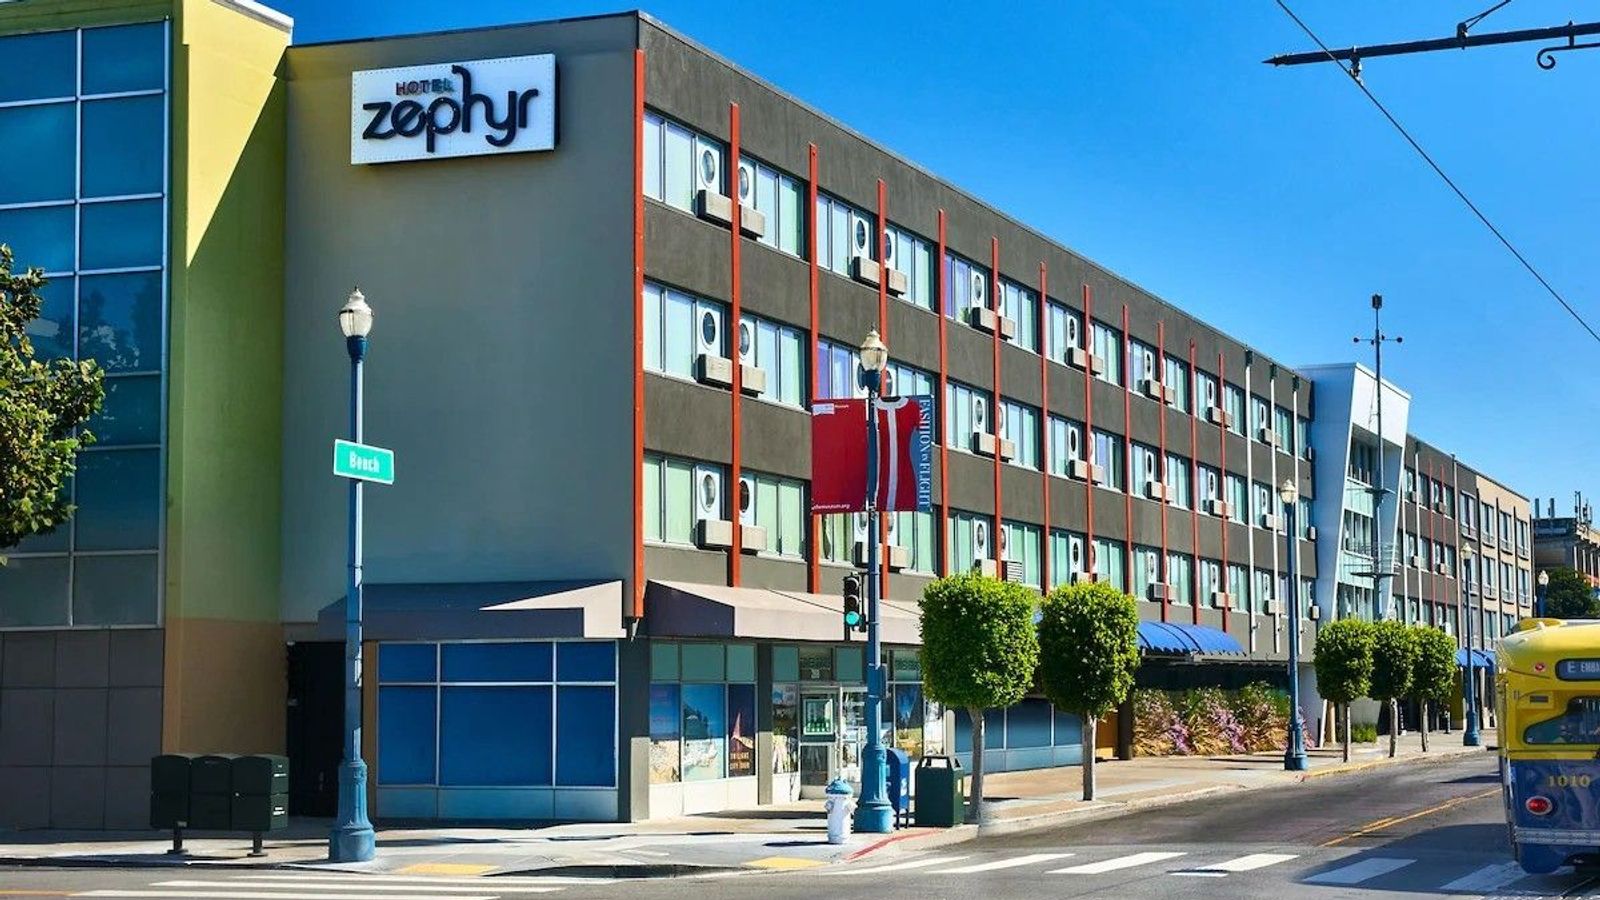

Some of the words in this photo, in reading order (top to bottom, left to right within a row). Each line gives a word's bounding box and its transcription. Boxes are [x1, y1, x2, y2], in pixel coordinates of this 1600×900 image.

[396, 78, 454, 96] HOTEL
[362, 64, 539, 153] zephyr
[919, 399, 931, 452] FASHION
[350, 450, 380, 473] Beach
[919, 462, 931, 507] FLIGHT
[1567, 660, 1577, 673] E
[1548, 774, 1591, 788] 1010
